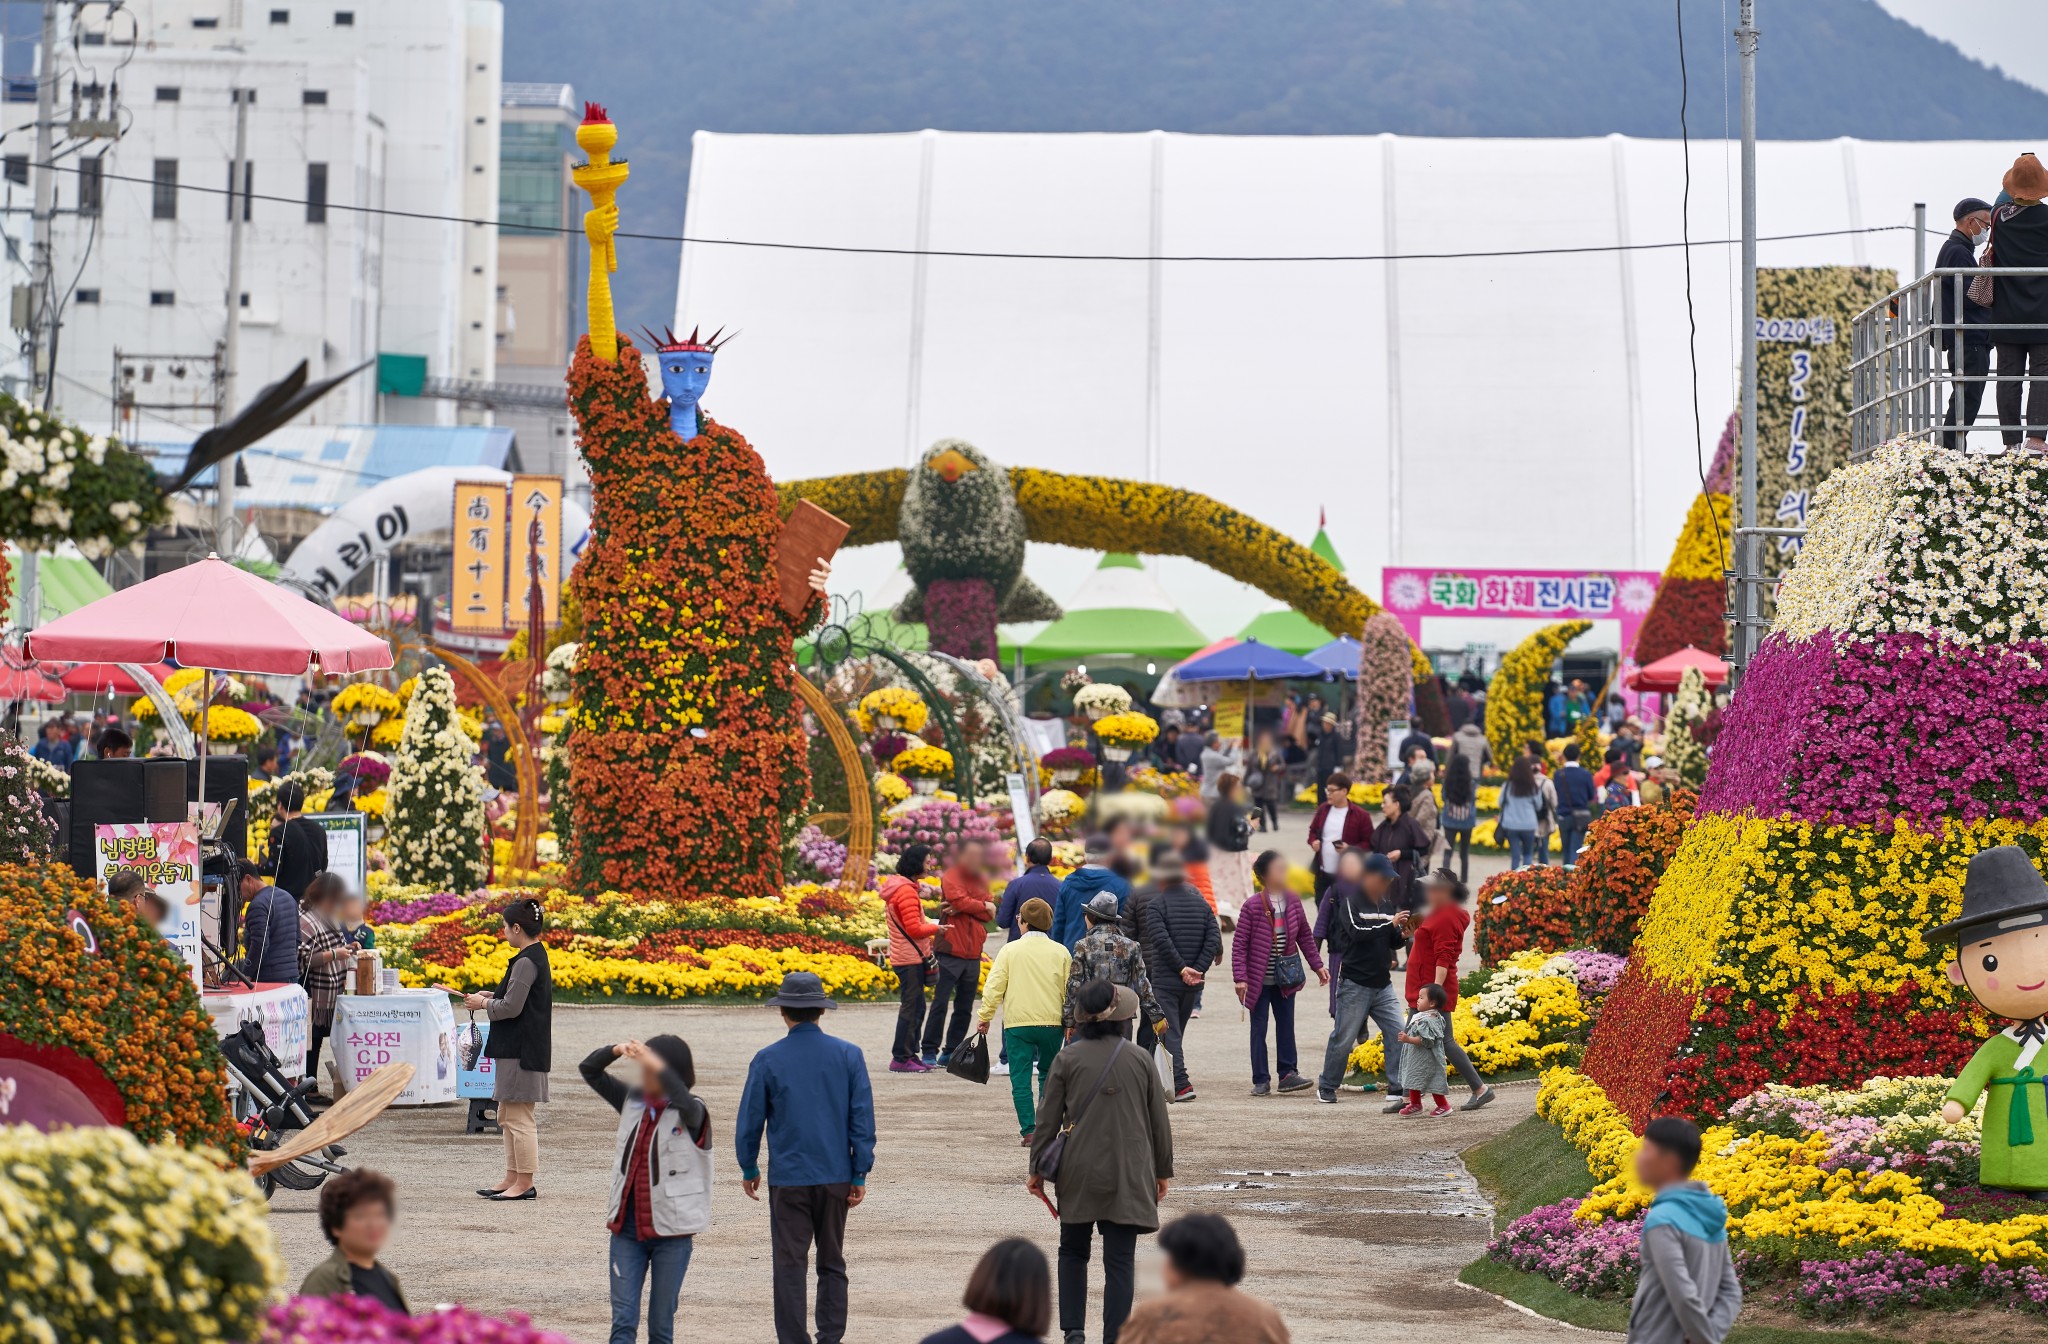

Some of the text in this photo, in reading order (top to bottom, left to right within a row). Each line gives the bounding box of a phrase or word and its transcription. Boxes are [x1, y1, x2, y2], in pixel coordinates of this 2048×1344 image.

[466, 496, 490, 613] 尚有十二
[1432, 580, 1476, 606] 국화
[100, 836, 157, 860] 심장병
[347, 1031, 401, 1047] 수와진
[357, 1050, 391, 1065] C.D
